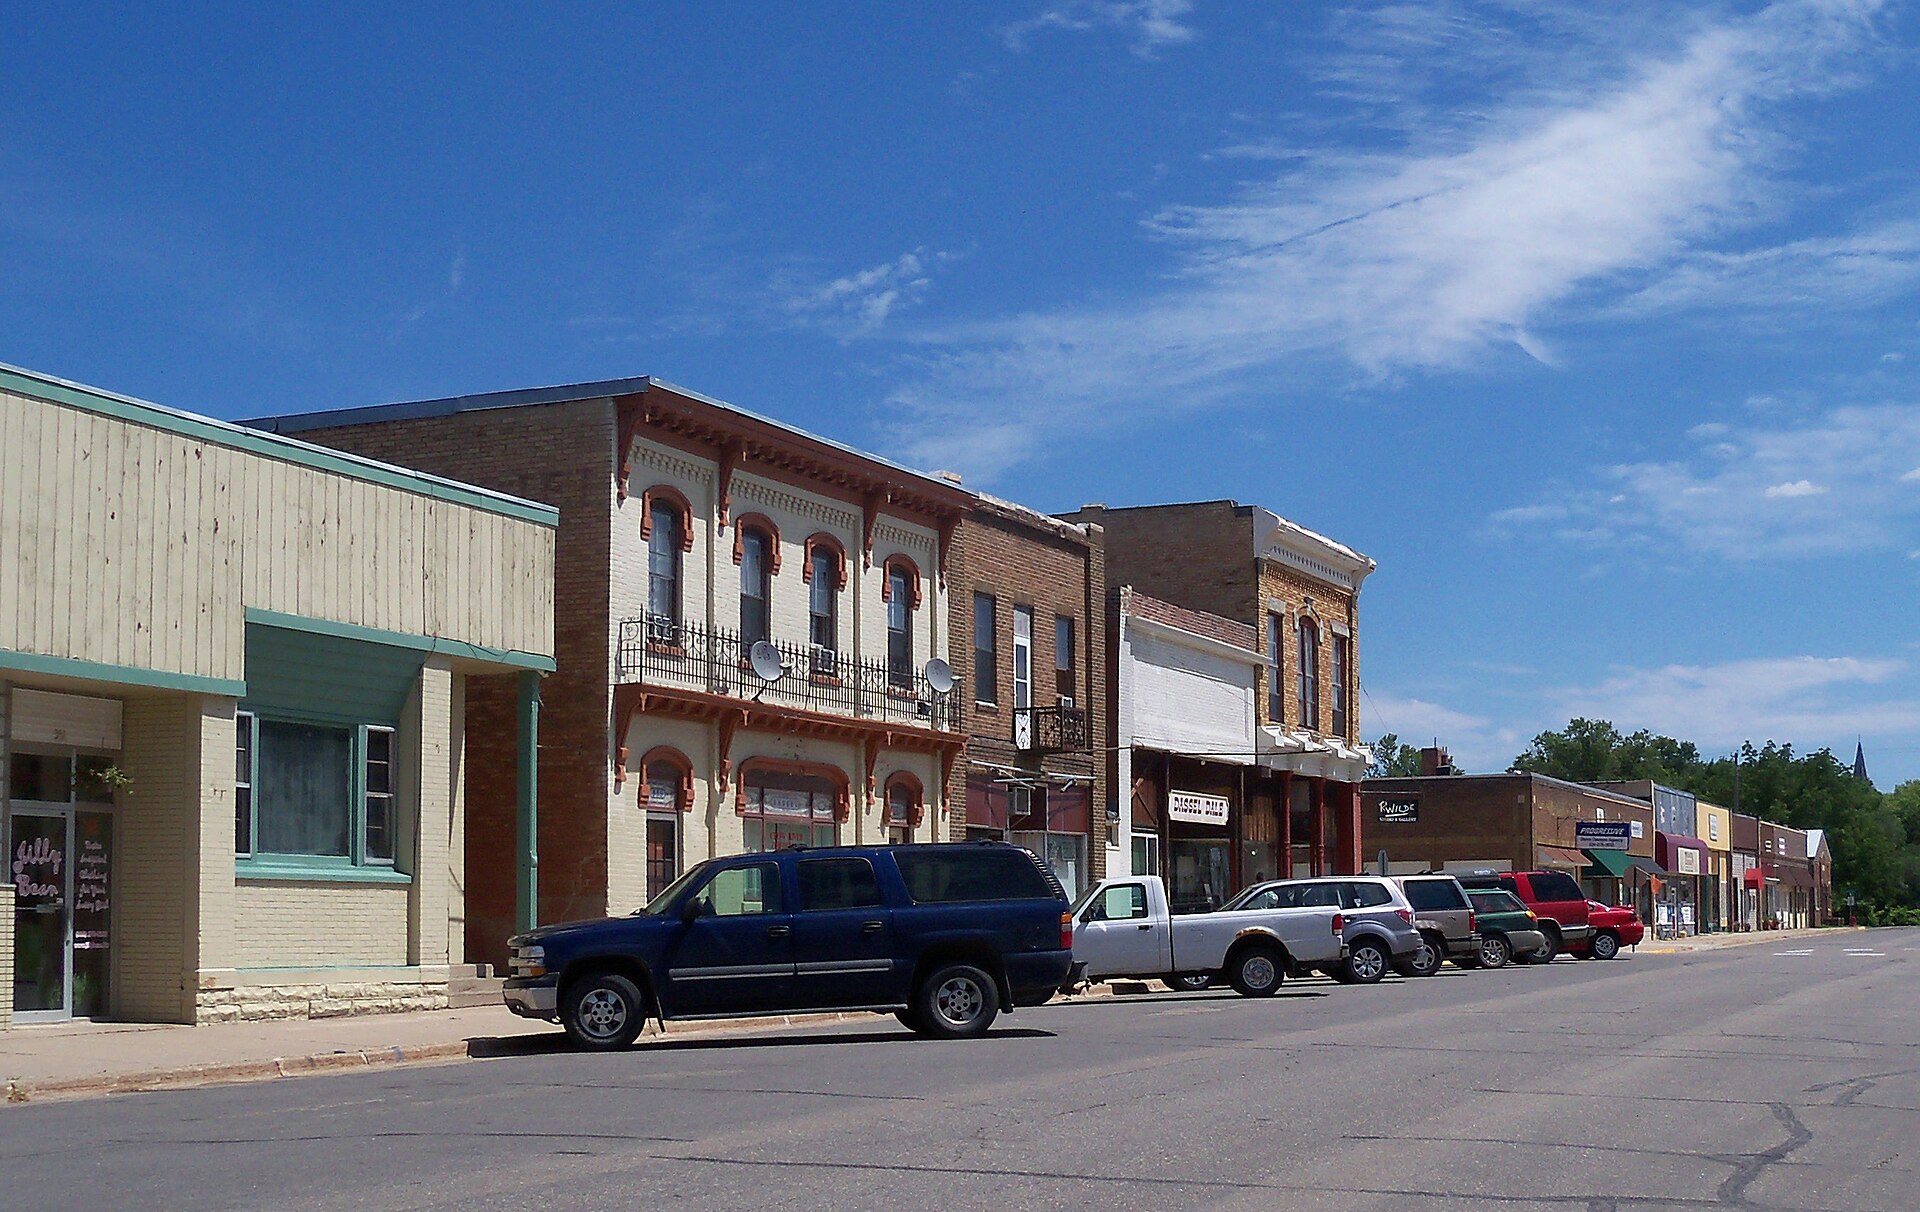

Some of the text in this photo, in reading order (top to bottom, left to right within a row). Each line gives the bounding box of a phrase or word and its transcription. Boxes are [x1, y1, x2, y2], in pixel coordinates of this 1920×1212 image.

[1173, 796, 1224, 817] DASSEL DALE
[12, 837, 62, 875] Jilly
[15, 874, 59, 897] Bean
